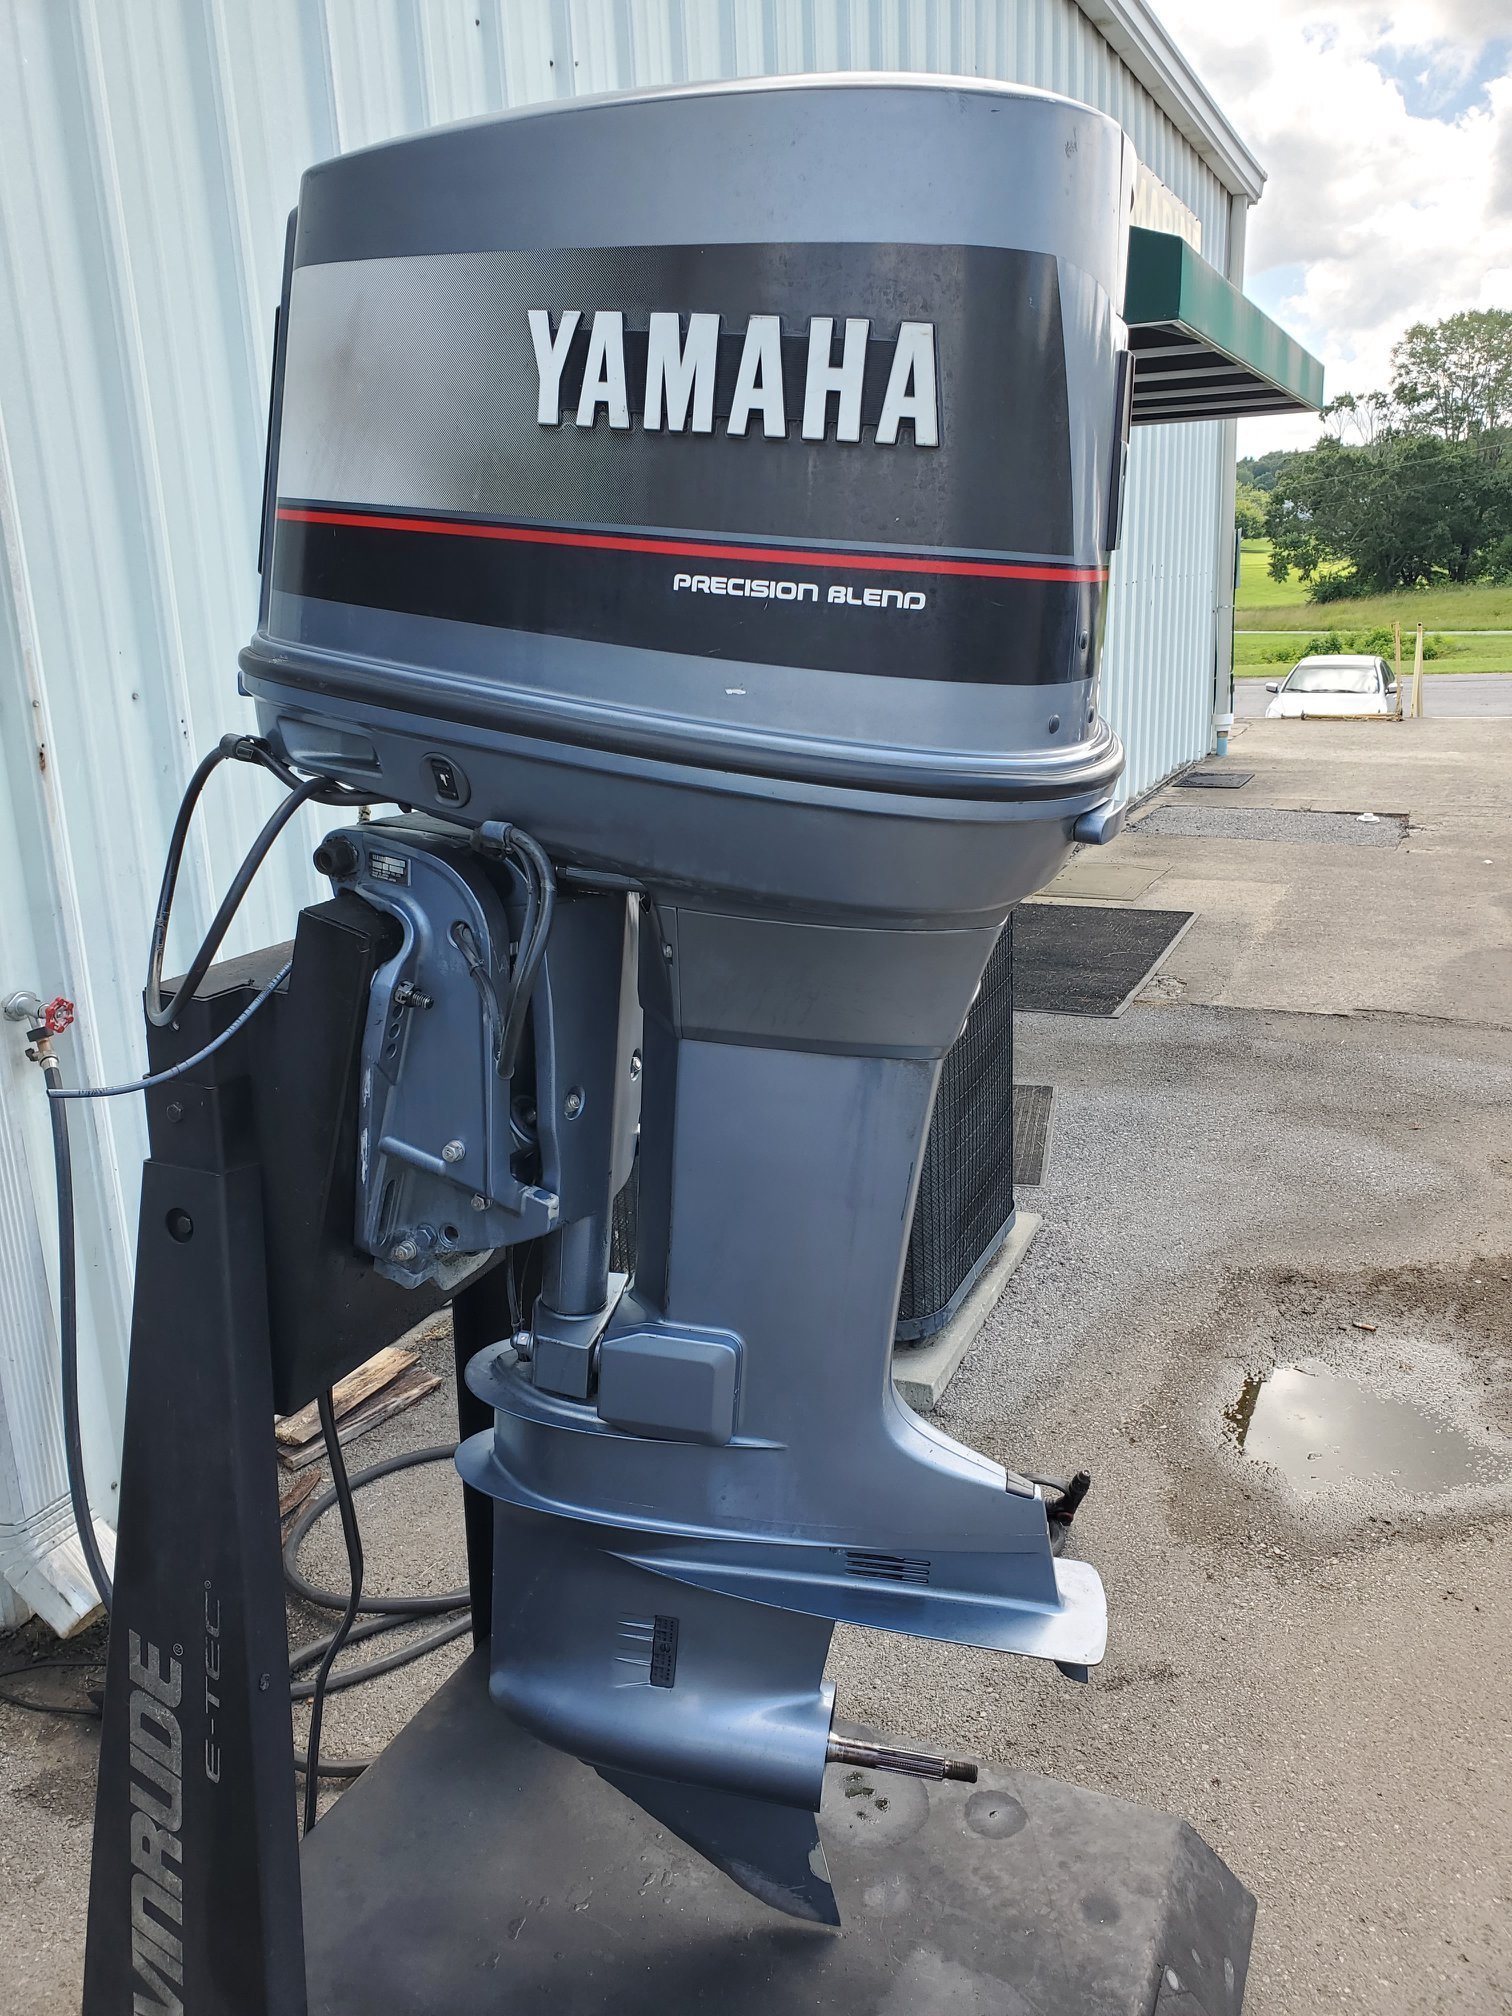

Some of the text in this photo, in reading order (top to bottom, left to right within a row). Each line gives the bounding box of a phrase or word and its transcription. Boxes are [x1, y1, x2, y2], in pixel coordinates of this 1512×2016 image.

[528, 310, 939, 447] YAMAHA
[673, 573, 926, 610] PRECISION BLEND
[129, 1628, 184, 2016] VINRUDE
